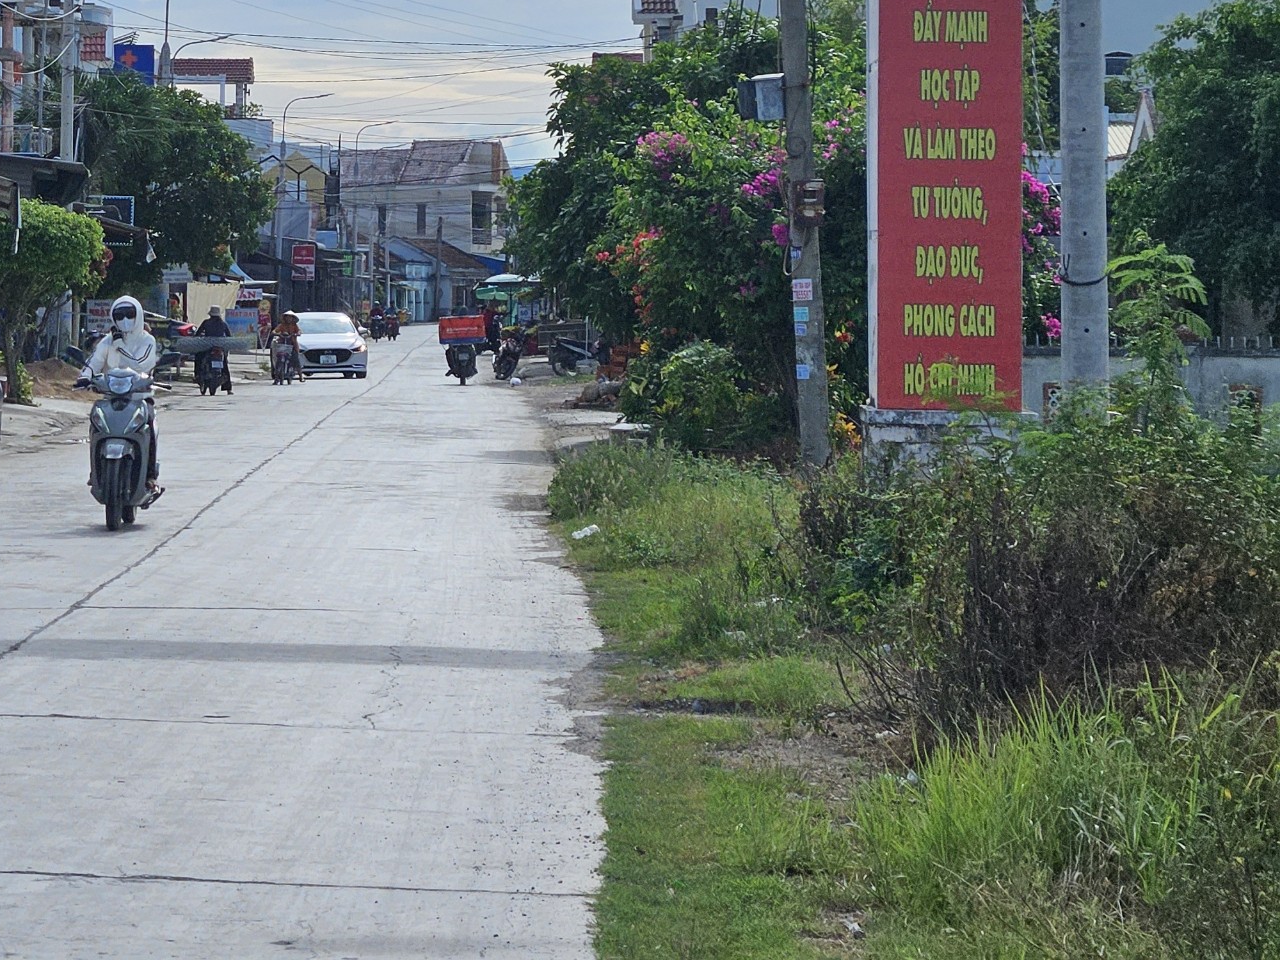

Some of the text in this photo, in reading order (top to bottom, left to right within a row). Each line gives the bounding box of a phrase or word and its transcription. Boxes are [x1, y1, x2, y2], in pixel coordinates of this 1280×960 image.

[913, 0, 988, 50] ĐẨY MẠNH
[921, 64, 980, 109] HỌC TẬP
[903, 121, 996, 160] VÀ LÀM THEO
[916, 239, 984, 284] ĐẠO ĐỨC,
[904, 299, 995, 337] PHONG CÁCH
[904, 352, 925, 396] HỒ
